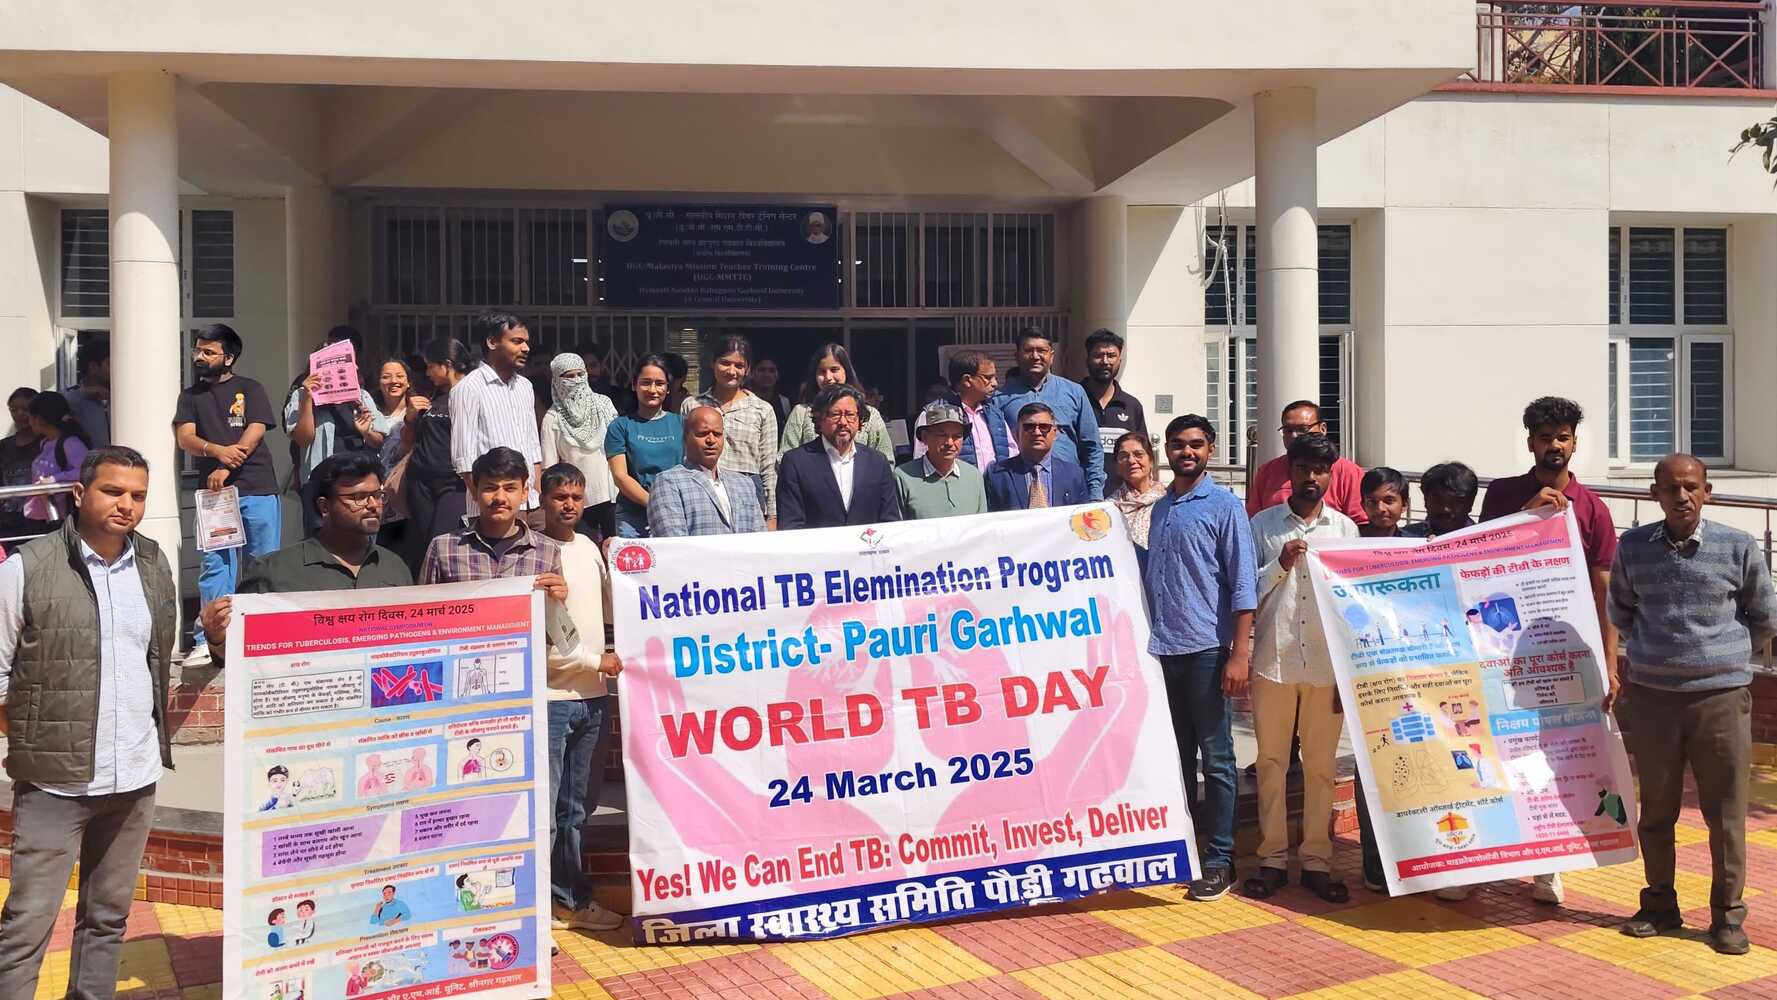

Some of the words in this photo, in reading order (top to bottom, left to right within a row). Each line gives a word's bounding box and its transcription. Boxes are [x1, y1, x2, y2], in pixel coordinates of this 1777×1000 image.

[1455, 538, 1467, 549] 24
[1469, 533, 1487, 547] मार्च
[639, 576, 766, 621] National
[774, 572, 816, 608] TB
[824, 561, 991, 605] Elemination
[997, 554, 1114, 593] Program
[1332, 573, 1440, 599] जगरूकता
[1460, 565, 1490, 579] फेफड़ों
[1491, 563, 1505, 576] की
[1507, 560, 1529, 574] टीबी
[1531, 557, 1542, 571] के
[1543, 555, 1569, 569] लक्षण
[338, 615, 354, 623] क्षय
[358, 610, 374, 622] रोग
[378, 610, 408, 621] दिवस,
[426, 605, 444, 616] मार्च
[448, 604, 474, 614] 2025
[246, 642, 277, 651] TRENDS
[295, 636, 348, 646] TUBERCULOSIS,
[352, 633, 387, 642] EMERGING
[390, 630, 431, 639] PATHOGENS
[438, 625, 484, 635] ENVIRONMENT
[672, 626, 832, 679] District-
[842, 613, 939, 662] Pauri
[950, 597, 1102, 651] Garhwal
[1511, 655, 1526, 666] का
[1527, 654, 1544, 667] पूरा
[661, 693, 884, 758] WORLD
[901, 683, 982, 729] TB
[1000, 666, 1108, 718] DAY
[768, 775, 814, 808] 24
[825, 762, 937, 801] March
[948, 748, 1034, 784] 2025
[636, 863, 691, 902] Yes!
[698, 859, 736, 893] We
[744, 854, 791, 887] Can
[798, 843, 844, 879] End
[849, 838, 892, 871] TB:
[898, 824, 997, 864] Commit,
[1003, 815, 1083, 849] Invest,
[1087, 804, 1168, 837] Deliver
[643, 918, 741, 944] जिला
[749, 898, 862, 939] स्वास्थ्य
[868, 876, 973, 921] समिति
